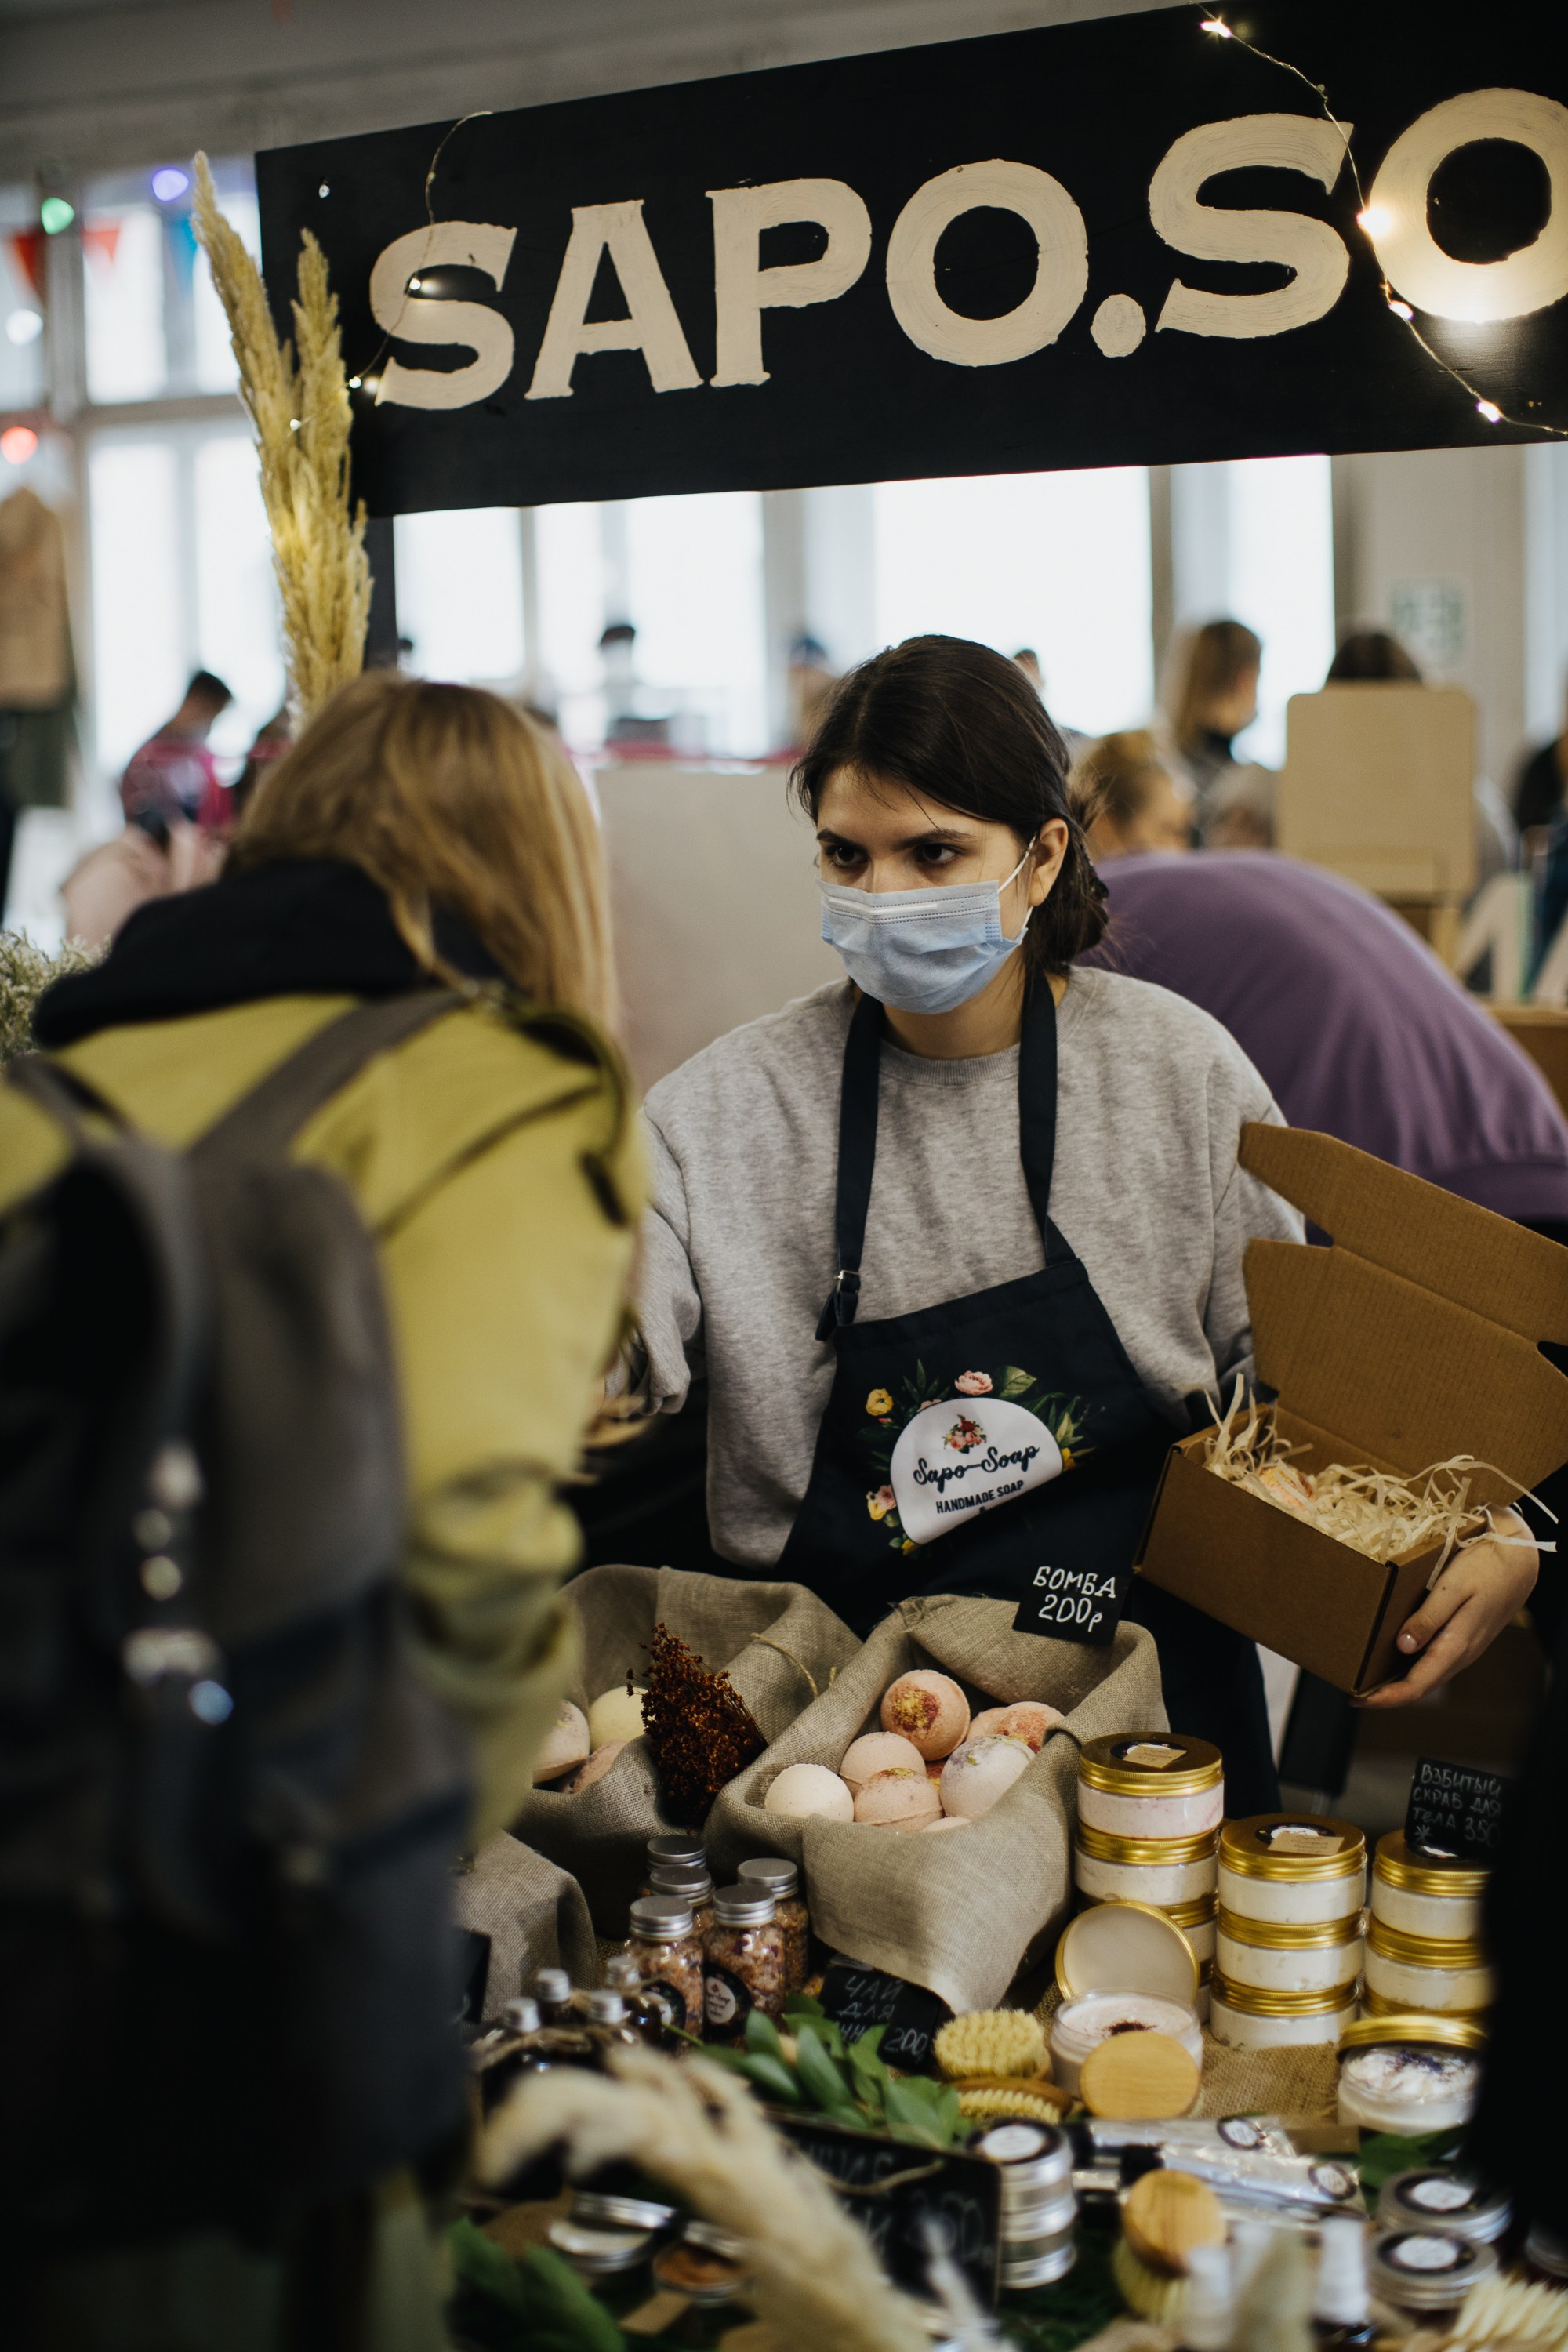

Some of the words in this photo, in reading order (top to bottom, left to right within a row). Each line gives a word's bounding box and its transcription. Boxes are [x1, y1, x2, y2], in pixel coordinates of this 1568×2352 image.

[935, 1490, 996, 1514] HANDMADE
[997, 1479, 1025, 1498] SOAP
[1033, 1566, 1116, 1599] БОМБА
[1420, 1763, 1501, 1798] ВЗБИТЫЙ
[1412, 1786, 1463, 1809] СКРАБ
[1469, 1796, 1501, 1819] ДЛЯ
[844, 1974, 904, 2001] ЧАЙ
[836, 2002, 895, 2021] ДЛЯ
